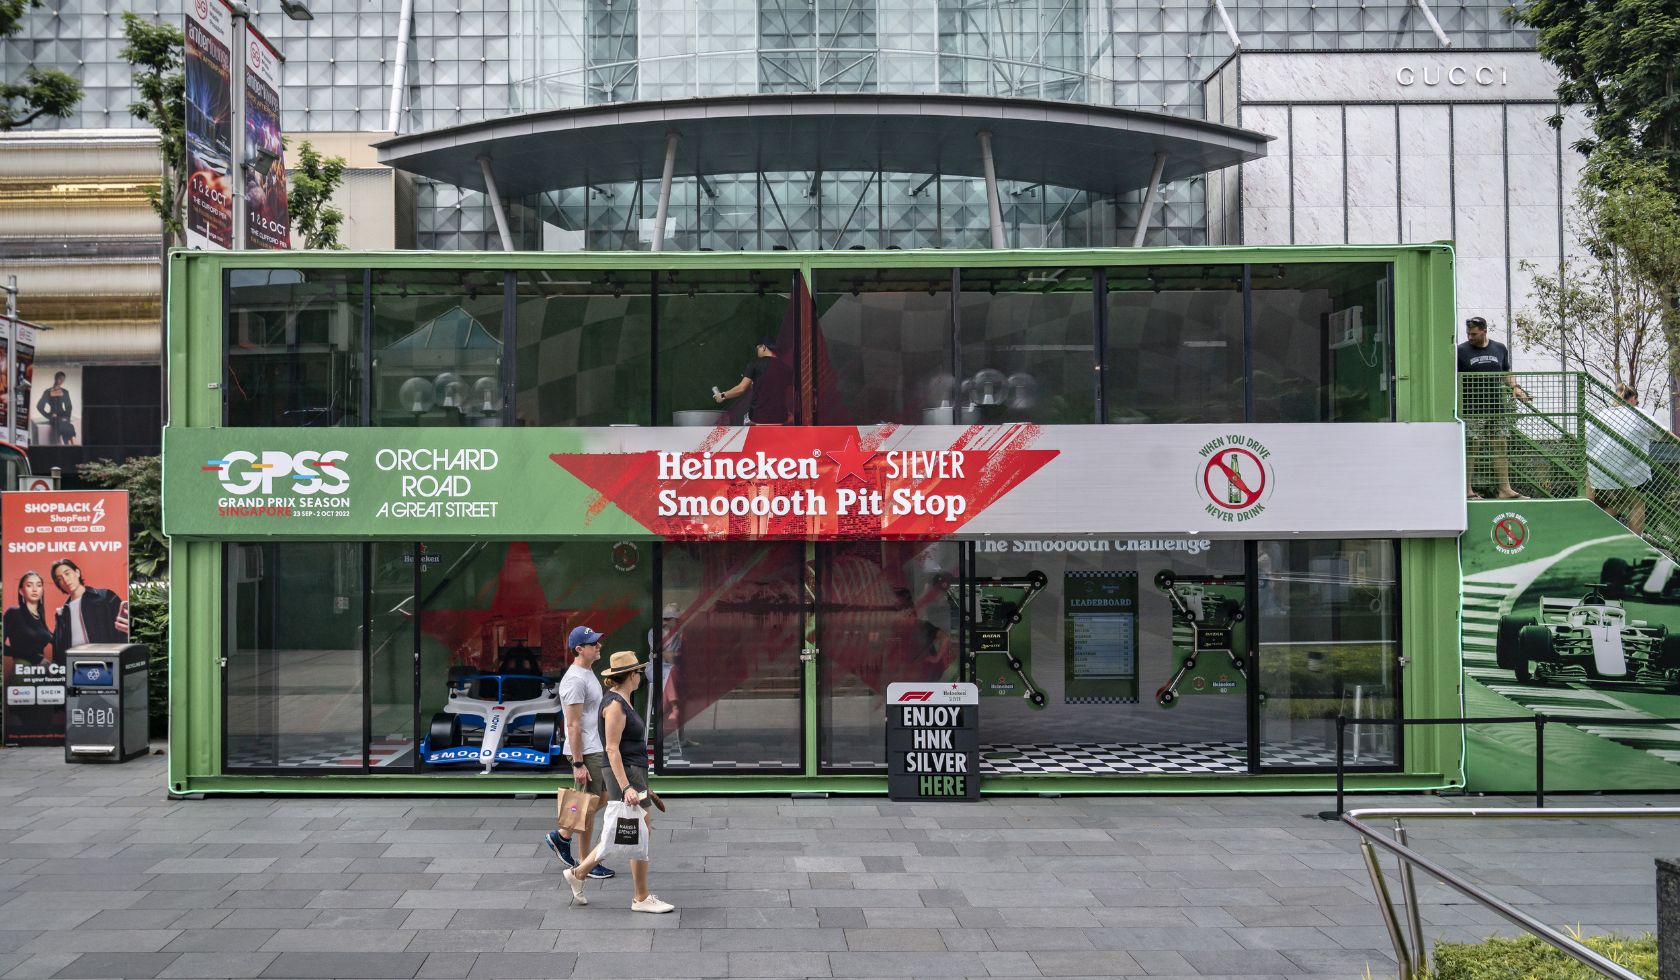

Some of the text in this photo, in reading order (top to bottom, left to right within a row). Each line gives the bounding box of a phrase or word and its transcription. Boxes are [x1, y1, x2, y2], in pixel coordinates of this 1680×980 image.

[1396, 66, 1507, 86] GUCCI
[193, 178, 197, 189] 1
[205, 185, 209, 197] 2
[211, 189, 226, 206] OCT
[193, 196, 201, 205] THE
[250, 212, 255, 222] 1
[262, 218, 268, 229] 2
[269, 221, 286, 236] OCT
[250, 228, 259, 237] THE
[1199, 435, 1271, 460] WHEN YOU DRIVE
[375, 448, 499, 471] ORCHARD
[886, 450, 966, 480] SILVER
[217, 450, 350, 495] GPSS
[402, 475, 471, 497] ROAD
[24, 503, 90, 513] SHOPBACK
[218, 497, 350, 508] GRAND PRIX SEASON
[375, 502, 498, 518] A GREAT STREET
[658, 488, 967, 522] Smooooth Pit Stop
[50, 514, 91, 523] ShopFest
[218, 506, 292, 517] SINGAPORE
[1205, 503, 1266, 522] NEVER DRINK
[1492, 513, 1506, 523] WHEN
[1515, 513, 1528, 524] DRIVE
[8, 541, 122, 553] SHOP LIKE A VVIP
[975, 540, 1009, 553] The
[1114, 539, 1211, 555] Challenge
[1495, 544, 1525, 555] NEVER DRINK
[404, 555, 440, 563] Heeken
[1070, 598, 1133, 607] LEADERBOARD
[15, 663, 66, 675] Earn Ca
[903, 706, 961, 726] ENJOY
[913, 730, 953, 749] HNK
[906, 752, 967, 773] SILVER
[920, 776, 965, 796] HERE
